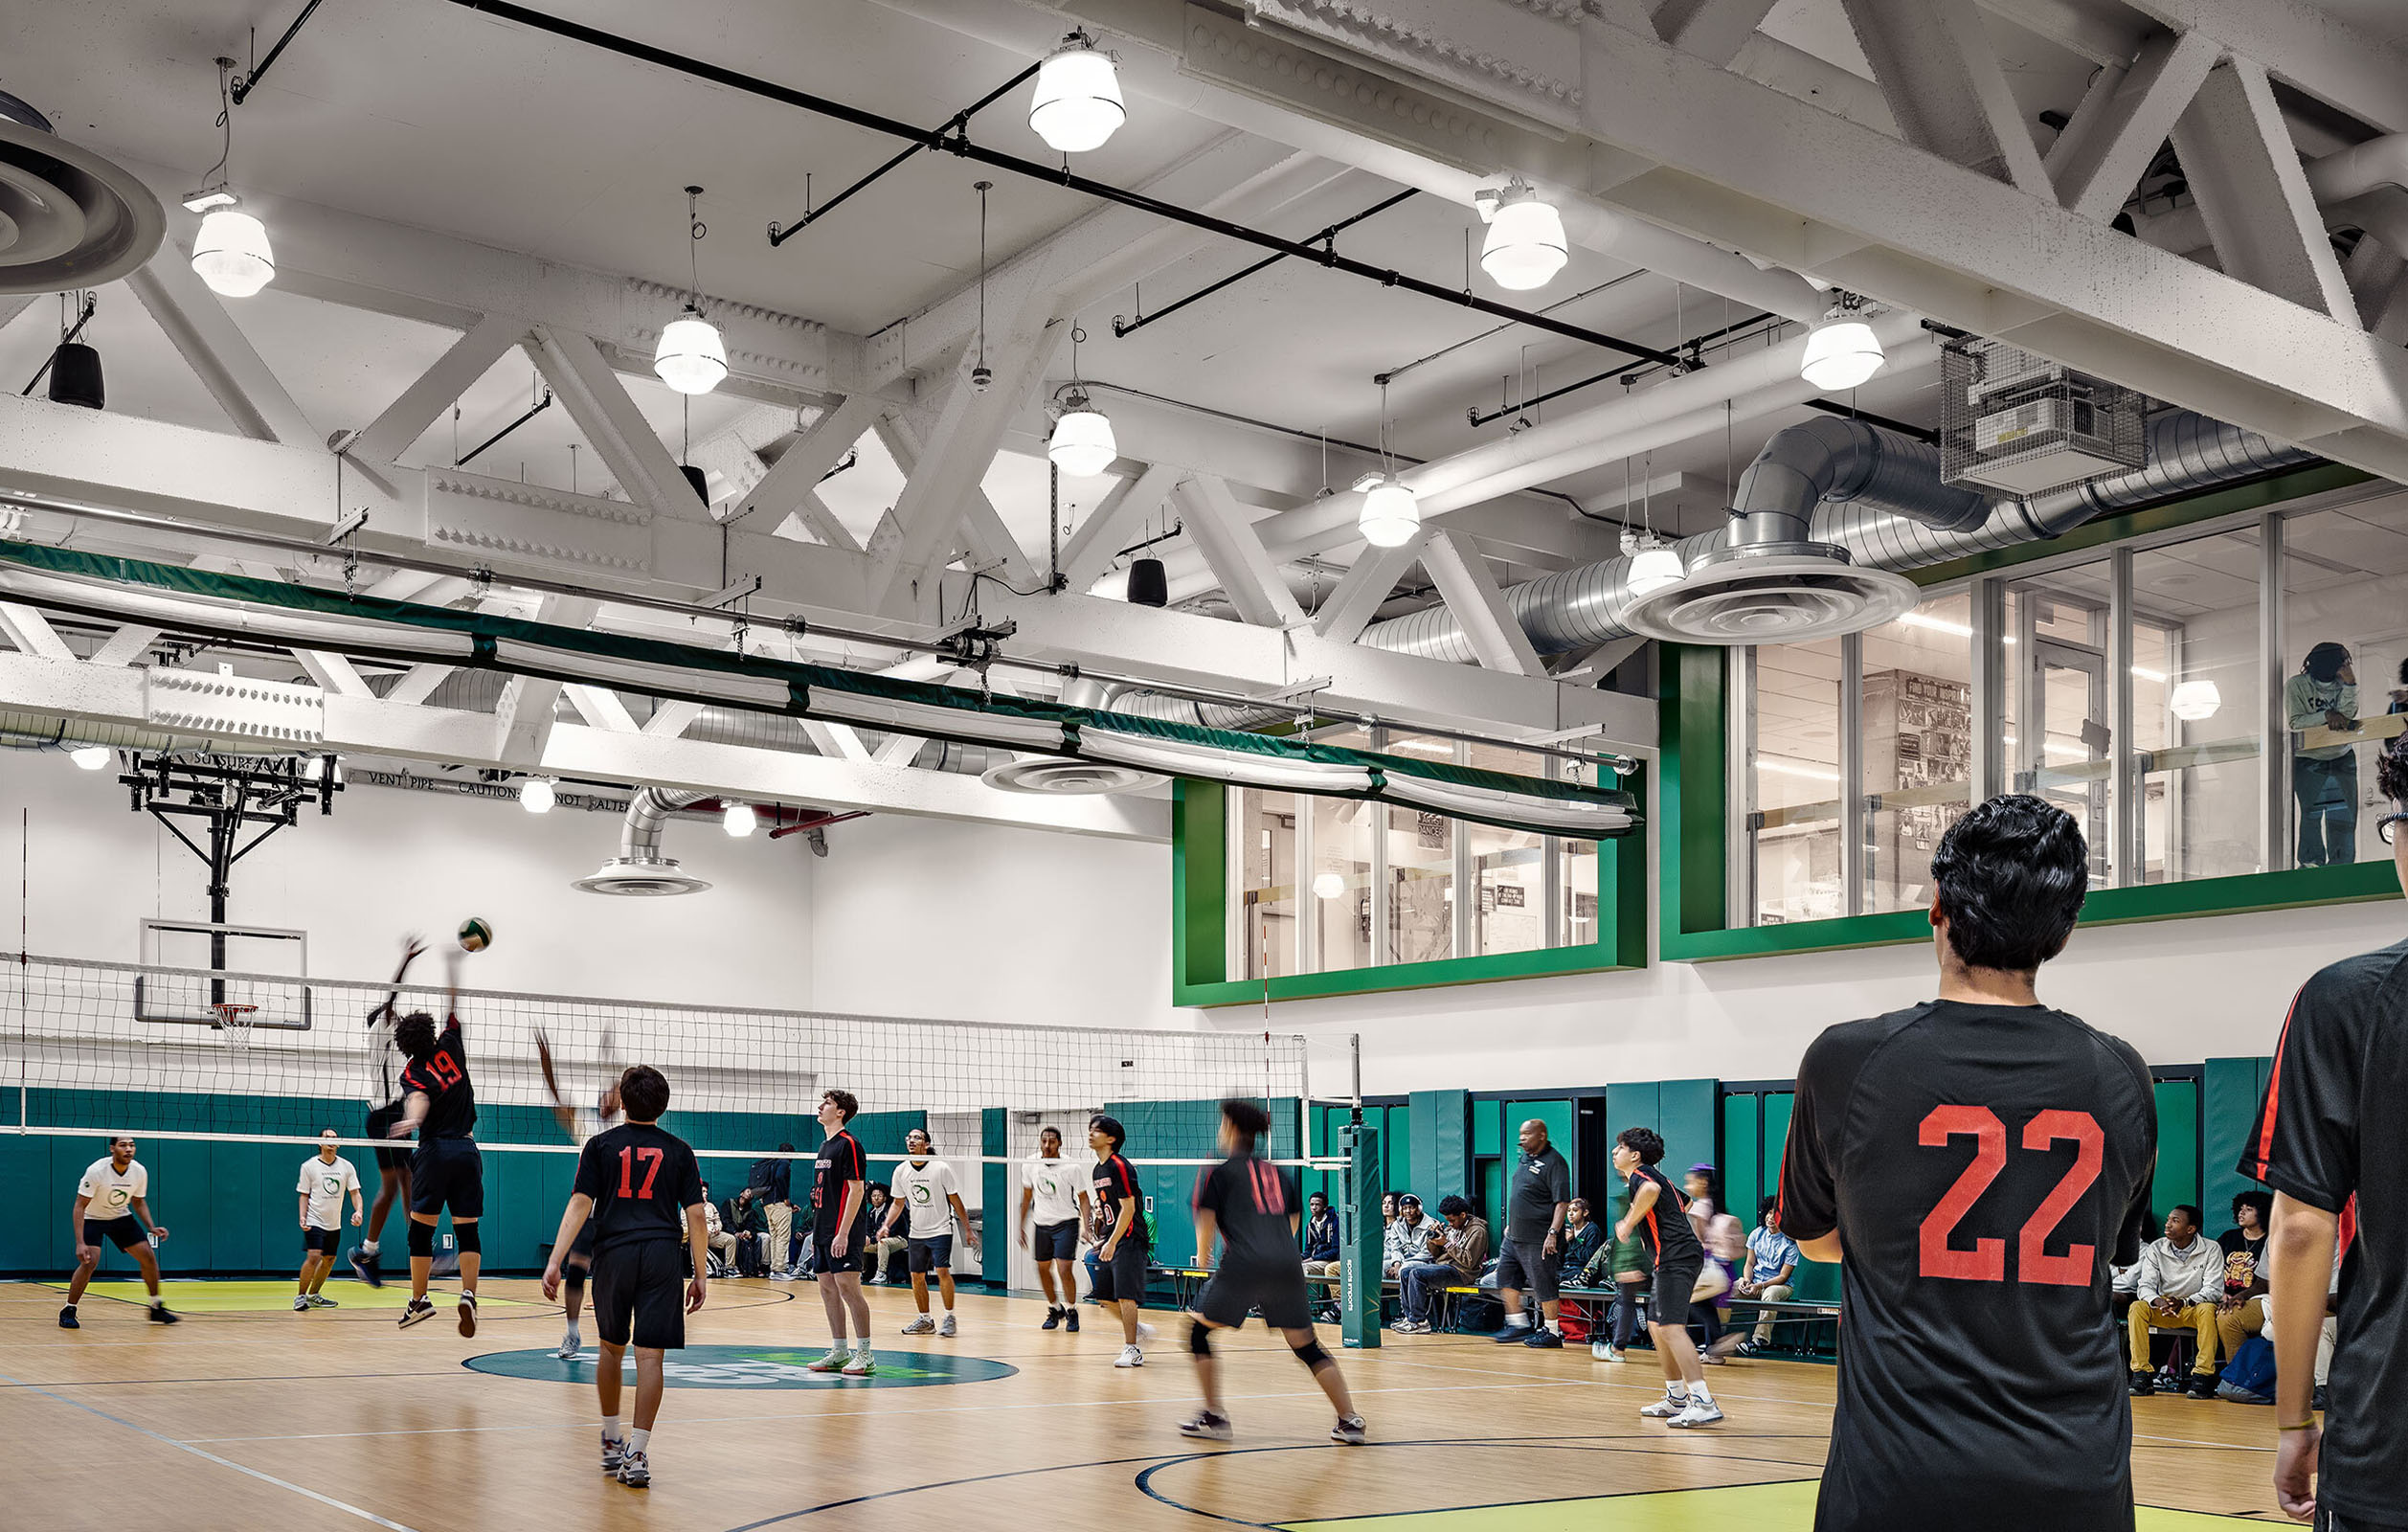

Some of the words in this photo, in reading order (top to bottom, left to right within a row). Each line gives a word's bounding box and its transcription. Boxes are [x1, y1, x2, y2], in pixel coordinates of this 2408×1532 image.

[368, 770, 403, 786] VENT
[459, 781, 520, 800] CAUTION:
[554, 794, 581, 806] NOT
[425, 1049, 461, 1092] 19
[618, 1145, 664, 1200] 17
[1918, 1104, 2104, 1287] 22
